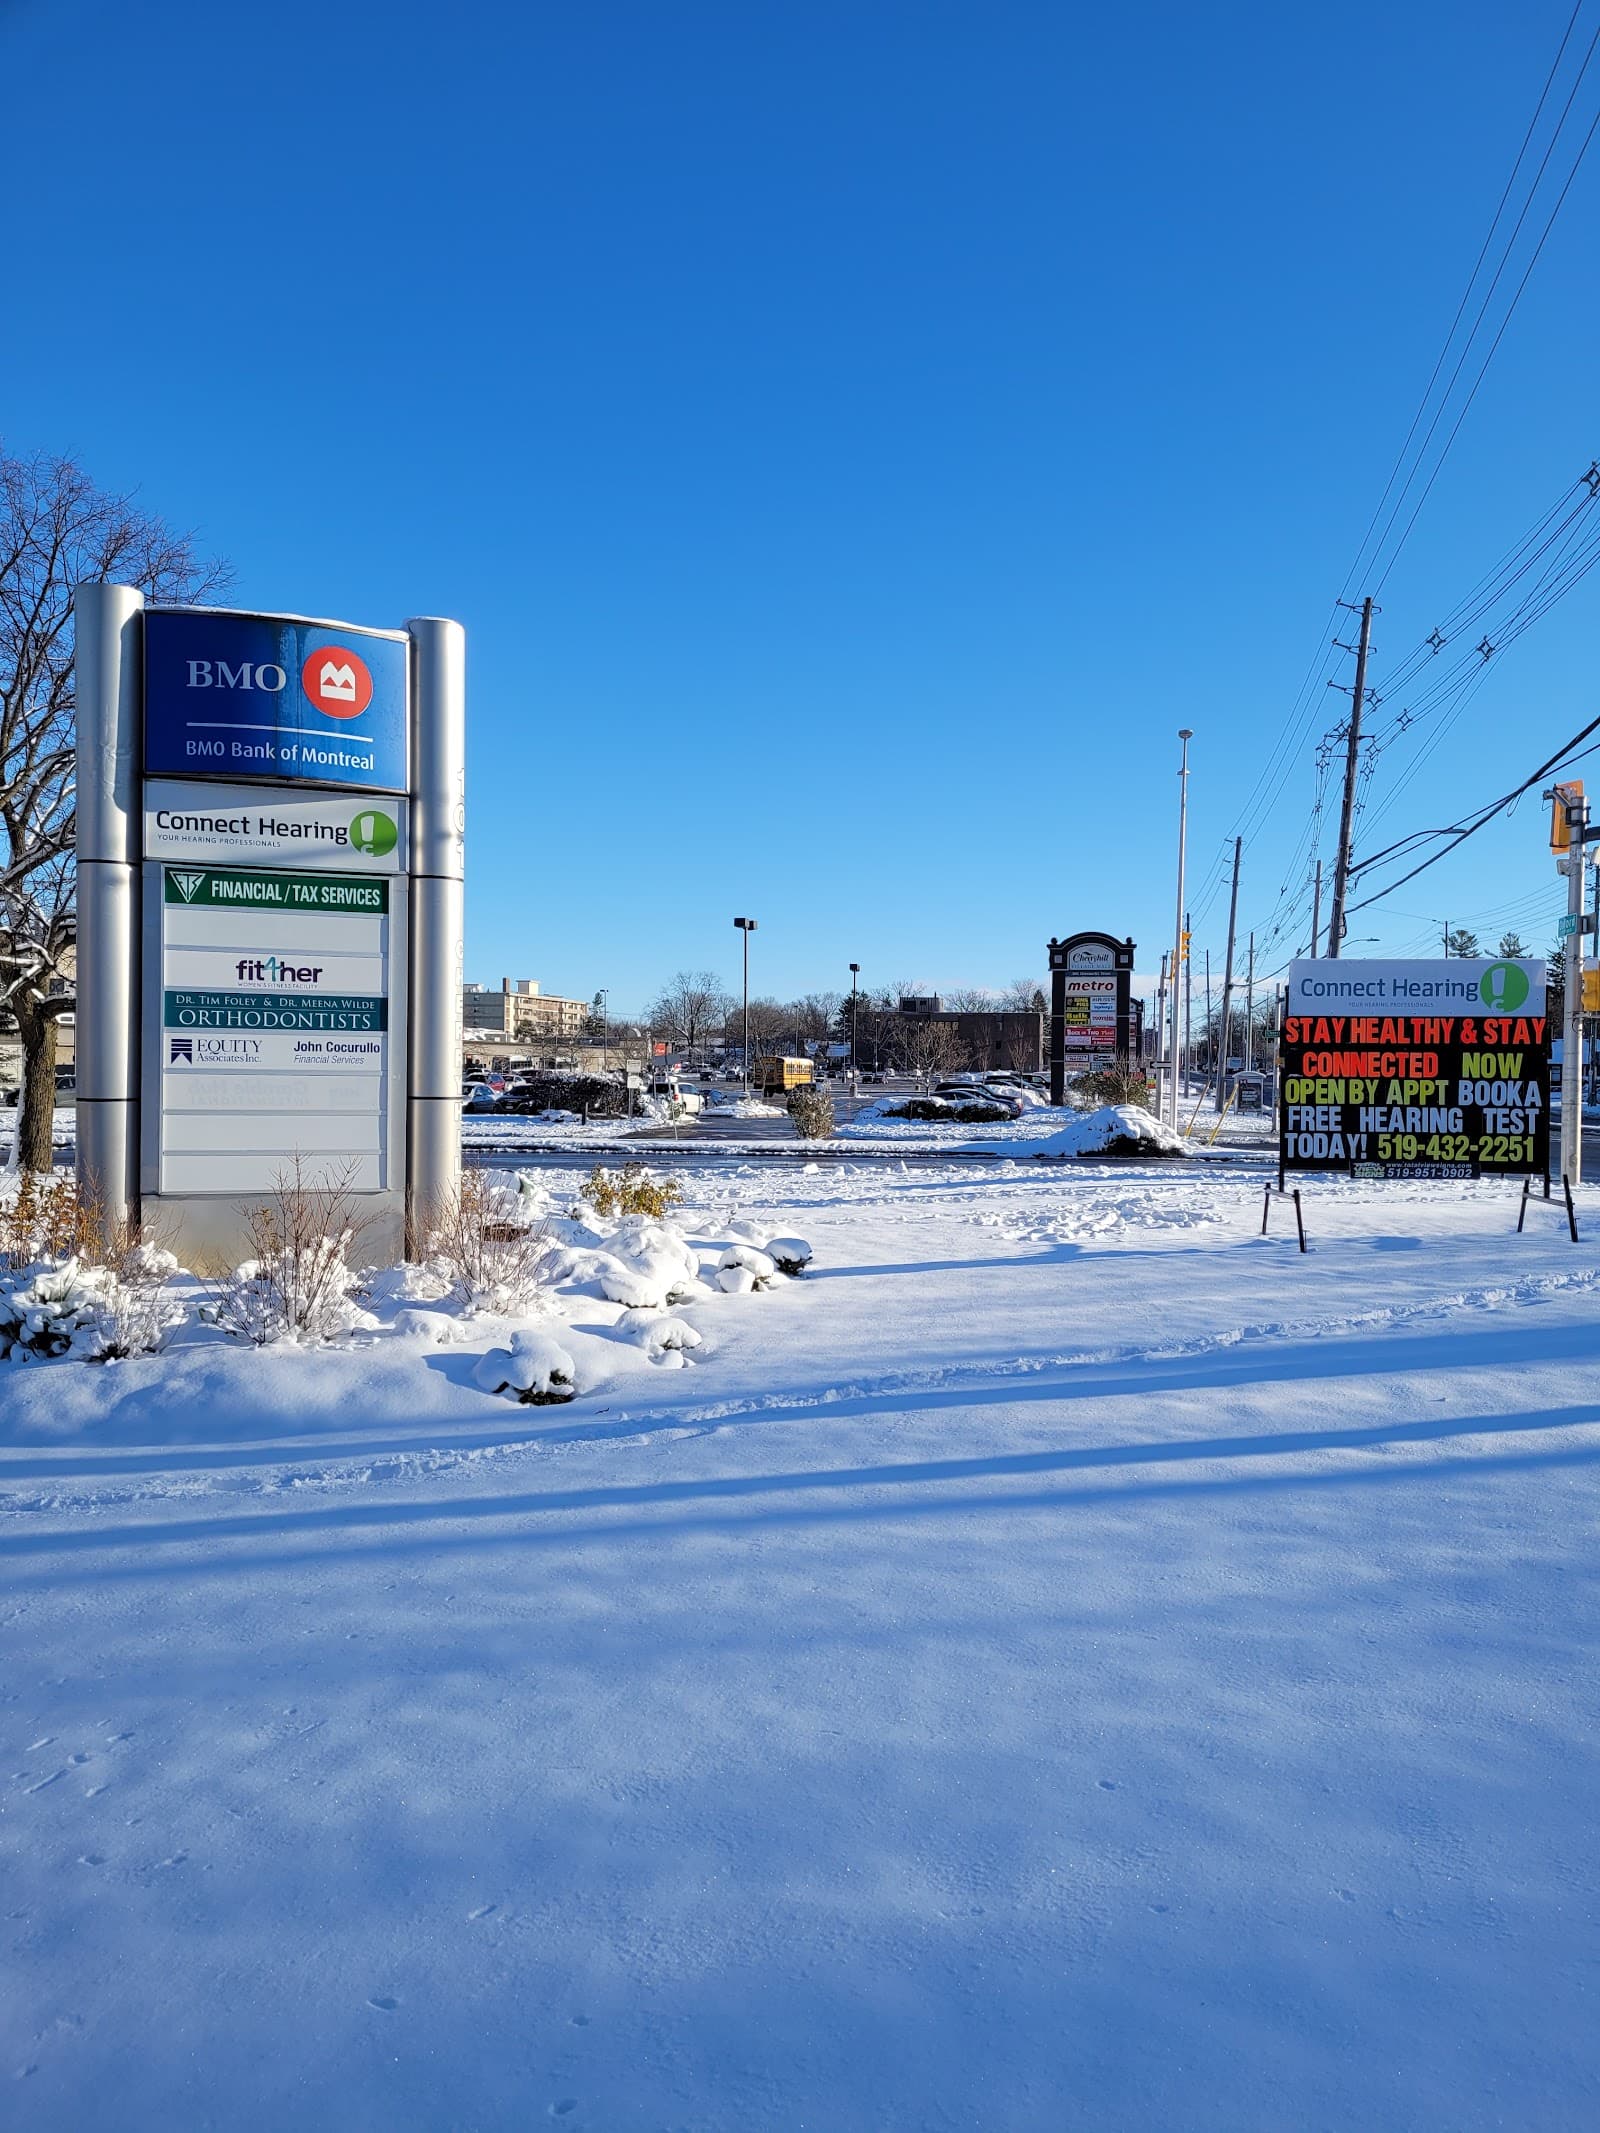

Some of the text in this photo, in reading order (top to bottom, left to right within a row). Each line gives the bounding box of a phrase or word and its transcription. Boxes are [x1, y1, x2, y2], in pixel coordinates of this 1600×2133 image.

[186, 660, 287, 692] BMO
[186, 740, 374, 770] BMO Bank of Montreal
[156, 810, 348, 846] Connect Hearing
[181, 835, 217, 844] HEARING
[219, 838, 281, 848] PROFESSIONALS
[211, 880, 282, 901] FINANCIAL
[293, 885, 318, 903] TAX
[321, 886, 380, 906] SERVICES
[235, 956, 323, 983] fit4her
[1068, 981, 1114, 991] metro
[1301, 978, 1479, 1001] Connect Hearing
[176, 995, 375, 1009] DR. TIM FOLEY & DR. MEENA WILDE
[179, 1010, 371, 1029] ORTHODONTISTS
[1285, 1017, 1546, 1045] STAY HEALTHY & STAY
[196, 1053, 262, 1063] Associates Inc.
[197, 1039, 262, 1055] EQUITY
[293, 1041, 380, 1054] John Cocurullo
[293, 1055, 365, 1065] Financial Services
[1303, 1051, 1523, 1079] CONNECTED NOW
[1285, 1079, 1345, 1105] OPEN
[1351, 1079, 1378, 1105] BY
[1386, 1080, 1449, 1106] APPT
[1288, 1105, 1540, 1135] FREE HEARING TEST
[1284, 1133, 1534, 1162] TODAY! 519-432-2251
[1387, 1168, 1473, 1178] 519-951-0902
